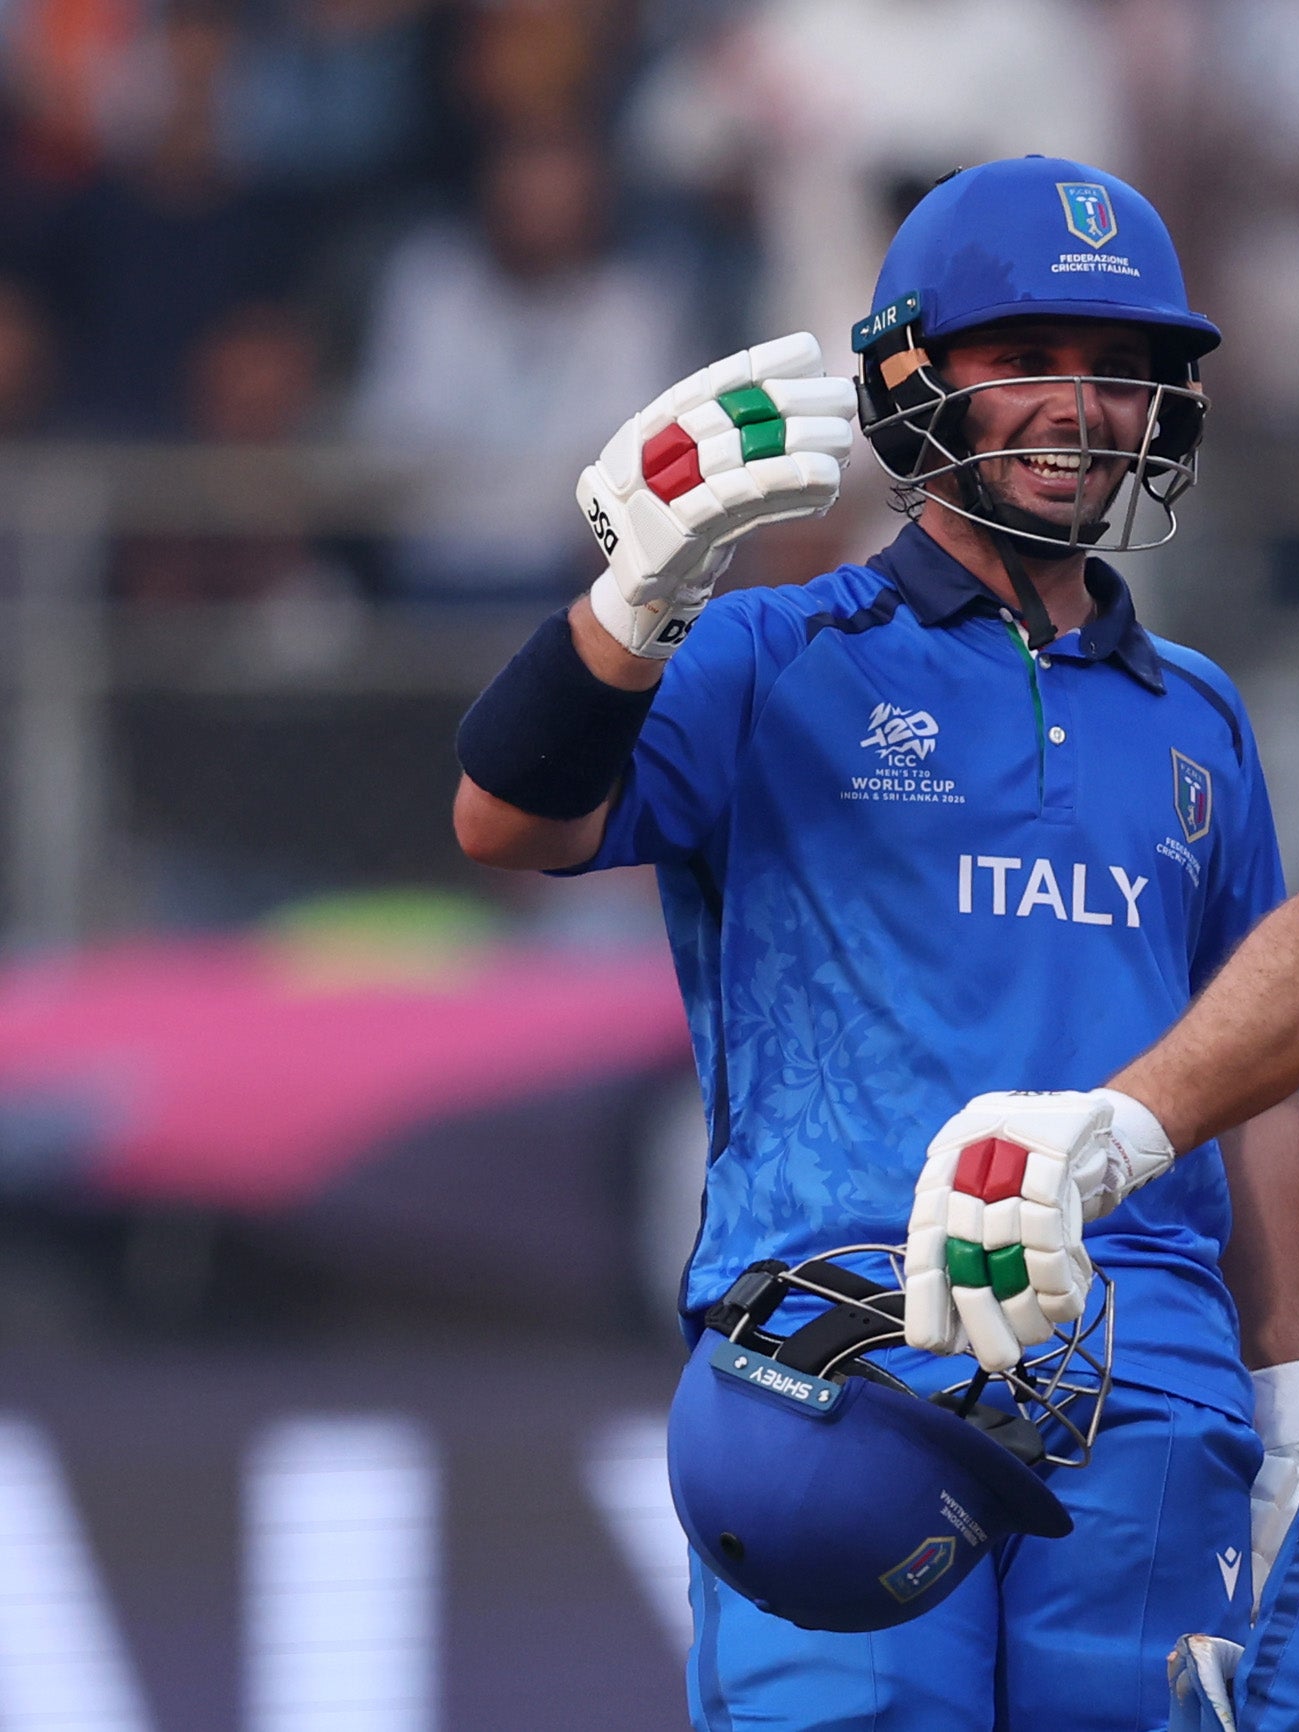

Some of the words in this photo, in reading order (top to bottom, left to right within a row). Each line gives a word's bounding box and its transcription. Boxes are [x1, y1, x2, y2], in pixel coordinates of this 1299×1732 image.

[1060, 254, 1129, 266] FEDERAZIONE
[1051, 263, 1096, 273] CRICKET
[1098, 263, 1141, 277] ITALIANA
[872, 305, 897, 335] AIR
[588, 497, 619, 556] DSC
[888, 754, 916, 767] ICC
[875, 768, 909, 778] MEN'S
[911, 769, 931, 778] T20
[851, 776, 916, 791] WORLD
[920, 779, 955, 793] CUP
[840, 791, 869, 800] INDIA
[872, 792, 880, 800] &
[882, 792, 900, 801] SRI
[903, 793, 939, 802] LANKA
[942, 794, 965, 803] 2026
[959, 854, 1149, 928] ITALY
[749, 1366, 813, 1400] SHREY
